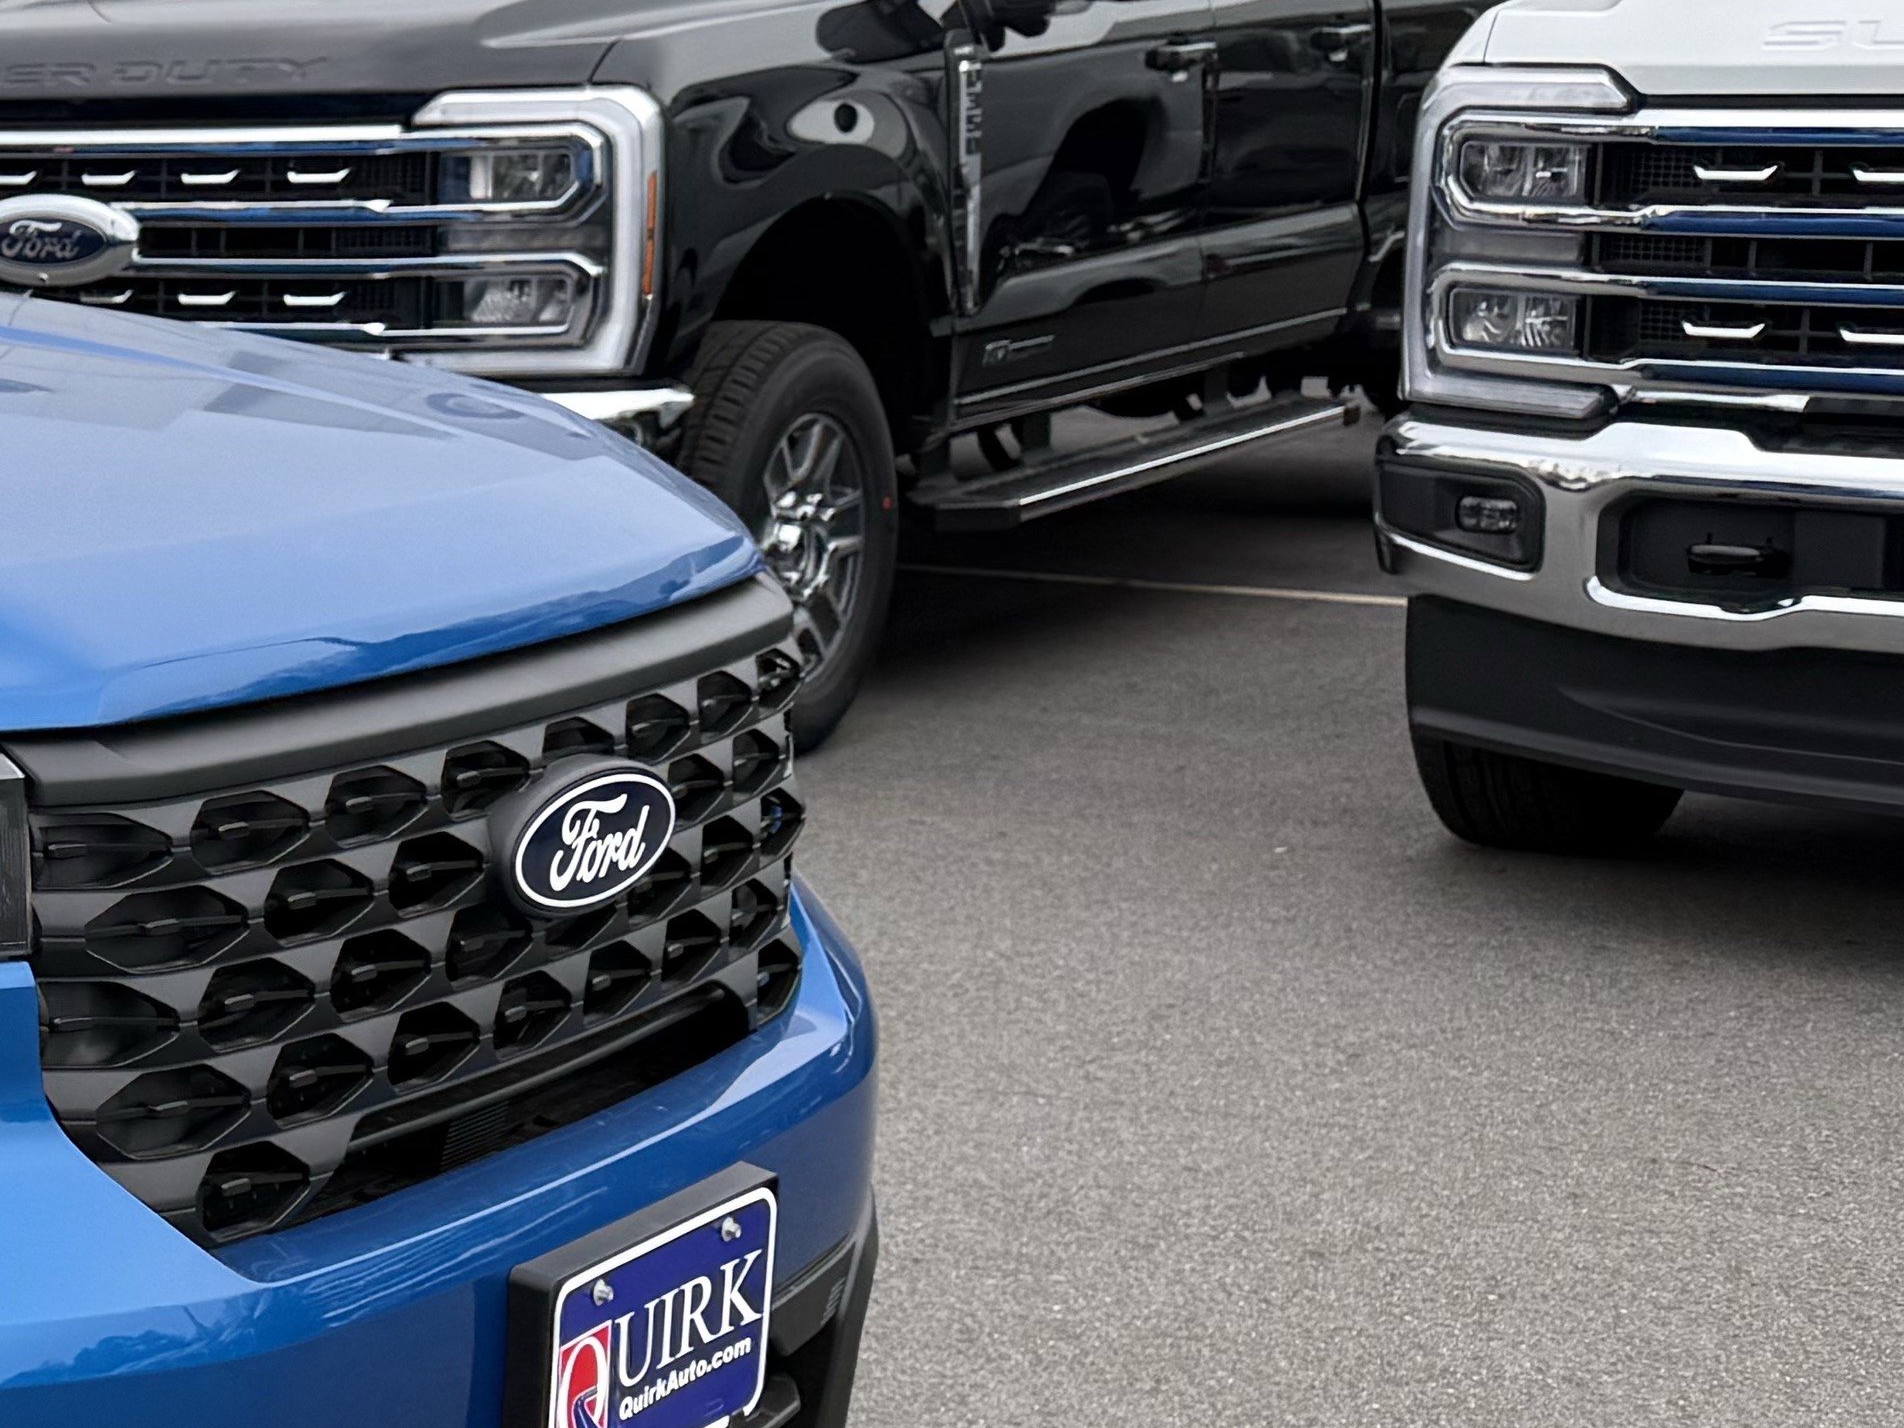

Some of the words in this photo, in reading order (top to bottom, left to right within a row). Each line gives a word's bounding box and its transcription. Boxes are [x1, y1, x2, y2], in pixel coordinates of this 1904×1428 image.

[111, 56, 329, 86] DUTY
[0, 218, 81, 260] Ford
[548, 792, 651, 892] Ford
[618, 1335, 752, 1422] QuirkAuto.com
